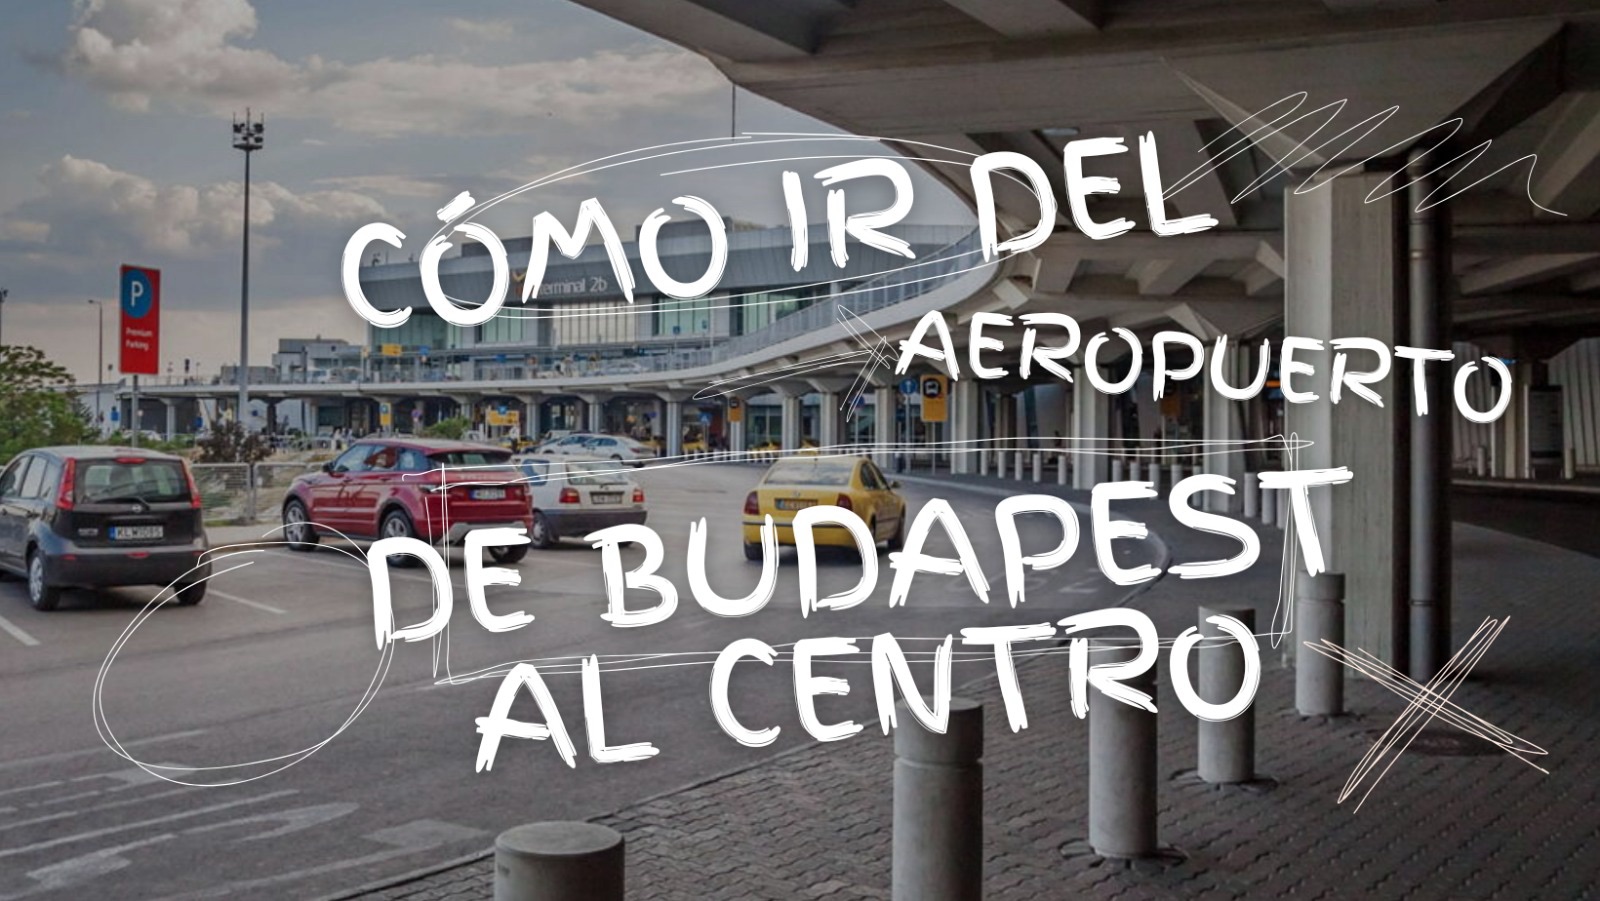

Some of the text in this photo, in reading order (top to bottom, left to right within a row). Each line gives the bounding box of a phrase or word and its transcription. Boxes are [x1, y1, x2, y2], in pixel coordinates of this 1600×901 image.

[130, 281, 144, 308] P
[126, 327, 153, 337] Premium
[126, 340, 149, 351] Parking
